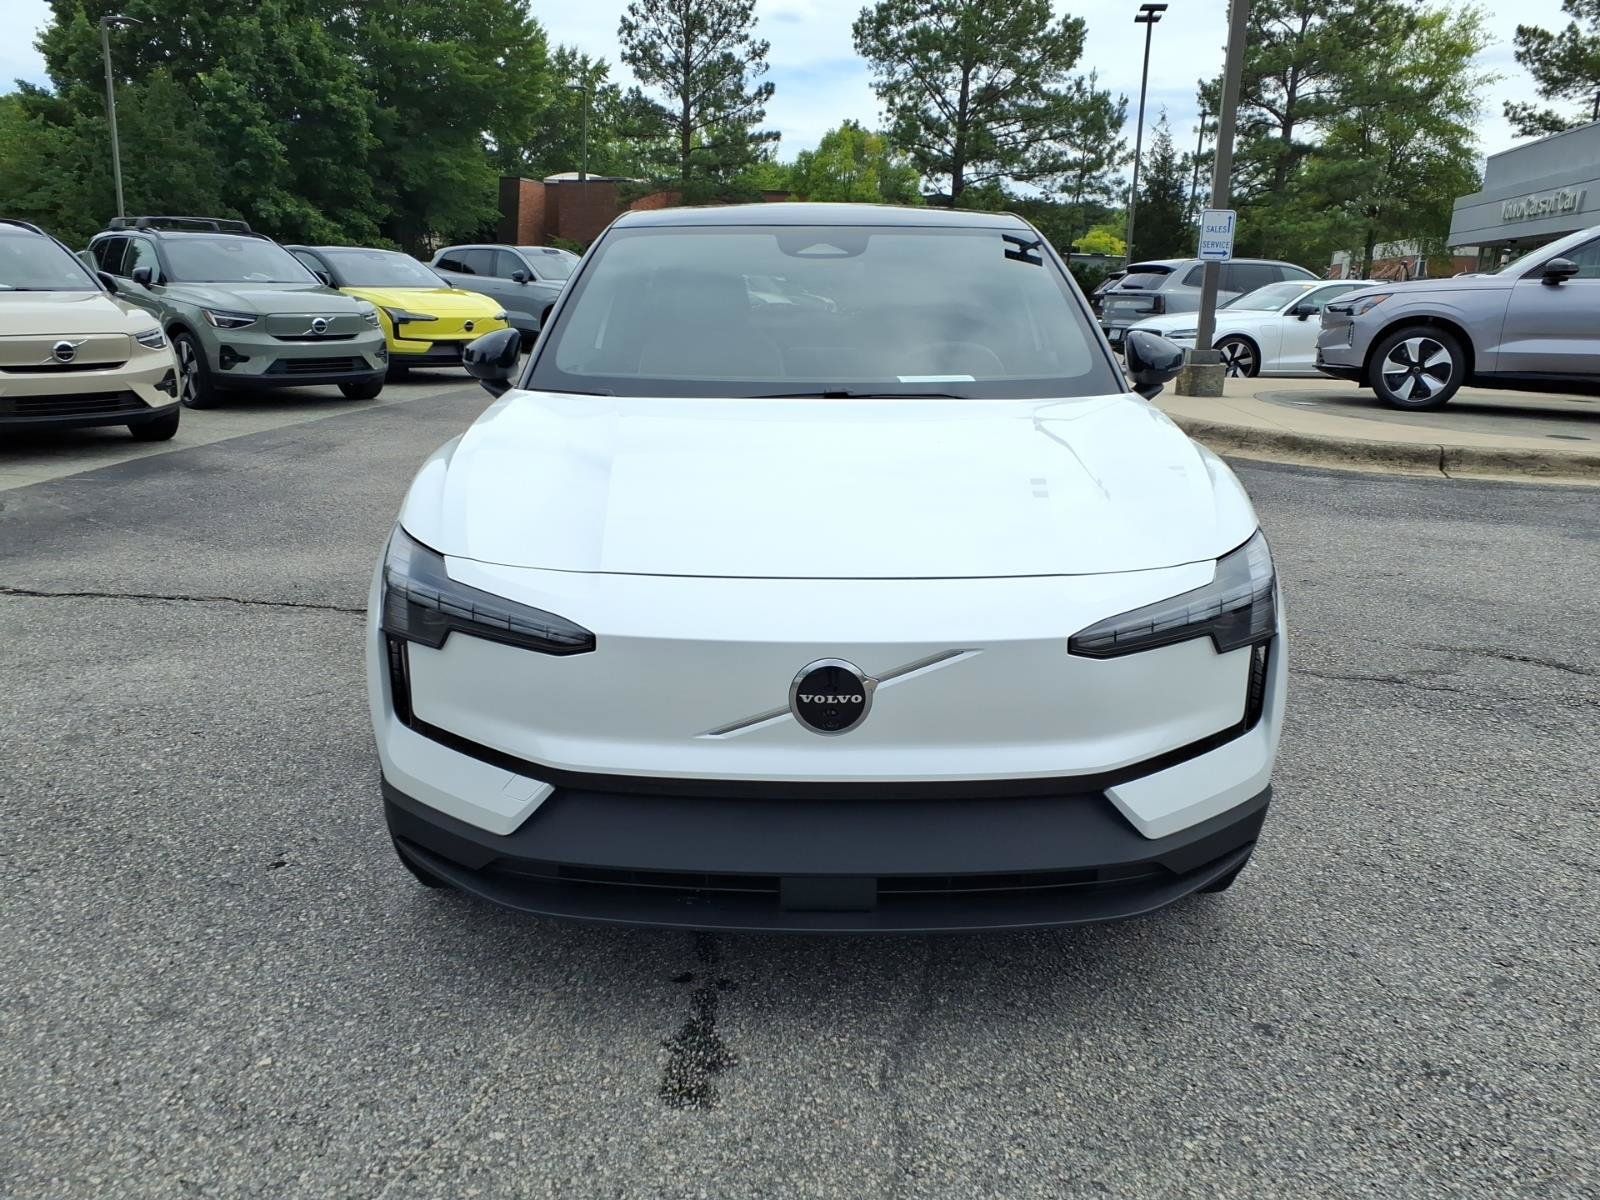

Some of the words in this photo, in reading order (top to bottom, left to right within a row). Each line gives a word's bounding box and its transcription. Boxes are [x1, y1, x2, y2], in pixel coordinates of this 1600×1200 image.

[1206, 225, 1227, 233] SALES
[1202, 240, 1230, 249] SERVICE
[799, 694, 863, 704] VOLVO
